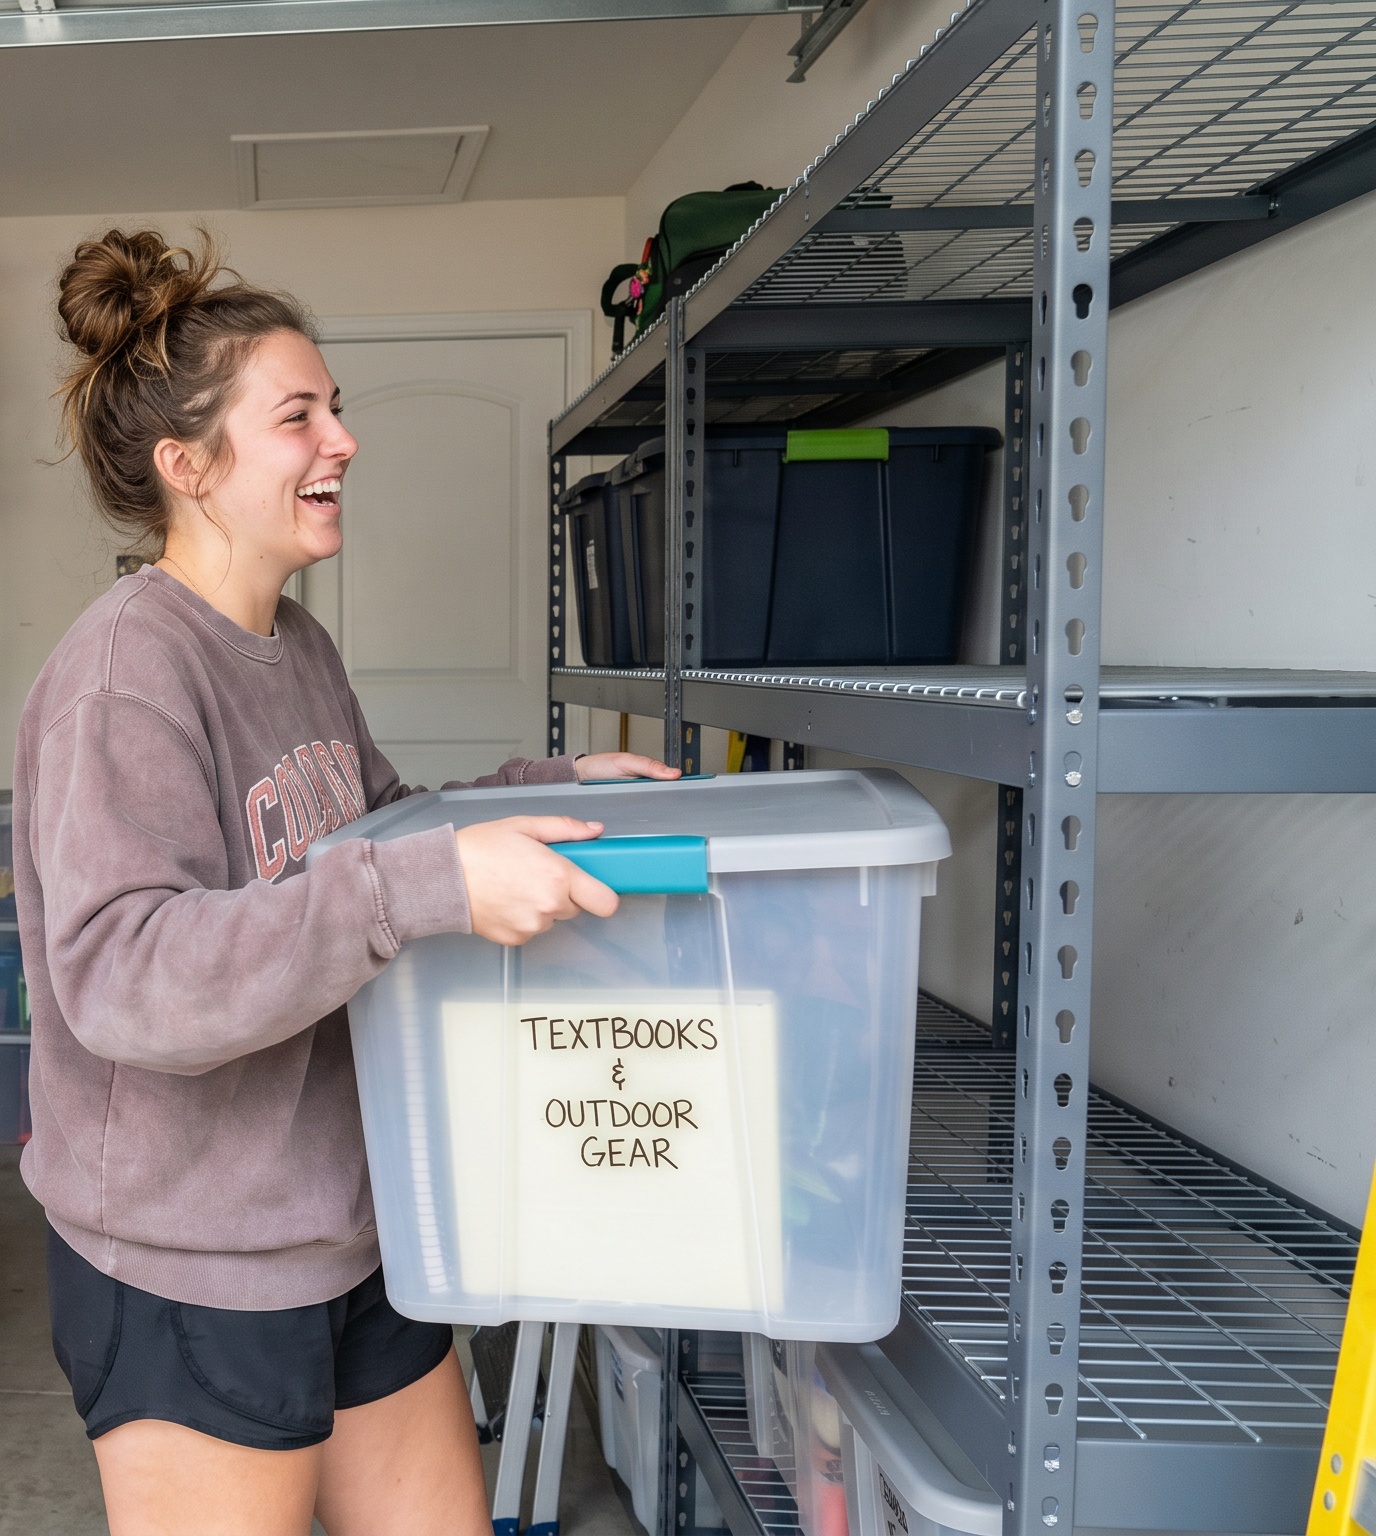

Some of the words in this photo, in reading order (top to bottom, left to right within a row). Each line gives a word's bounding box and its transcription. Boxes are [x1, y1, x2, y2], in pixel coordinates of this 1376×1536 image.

[520, 1016, 718, 1051] TEXTBOOKS
[611, 1057, 626, 1091] &
[545, 1098, 699, 1130] OUTDOOR
[580, 1136, 679, 1170] GEAR
